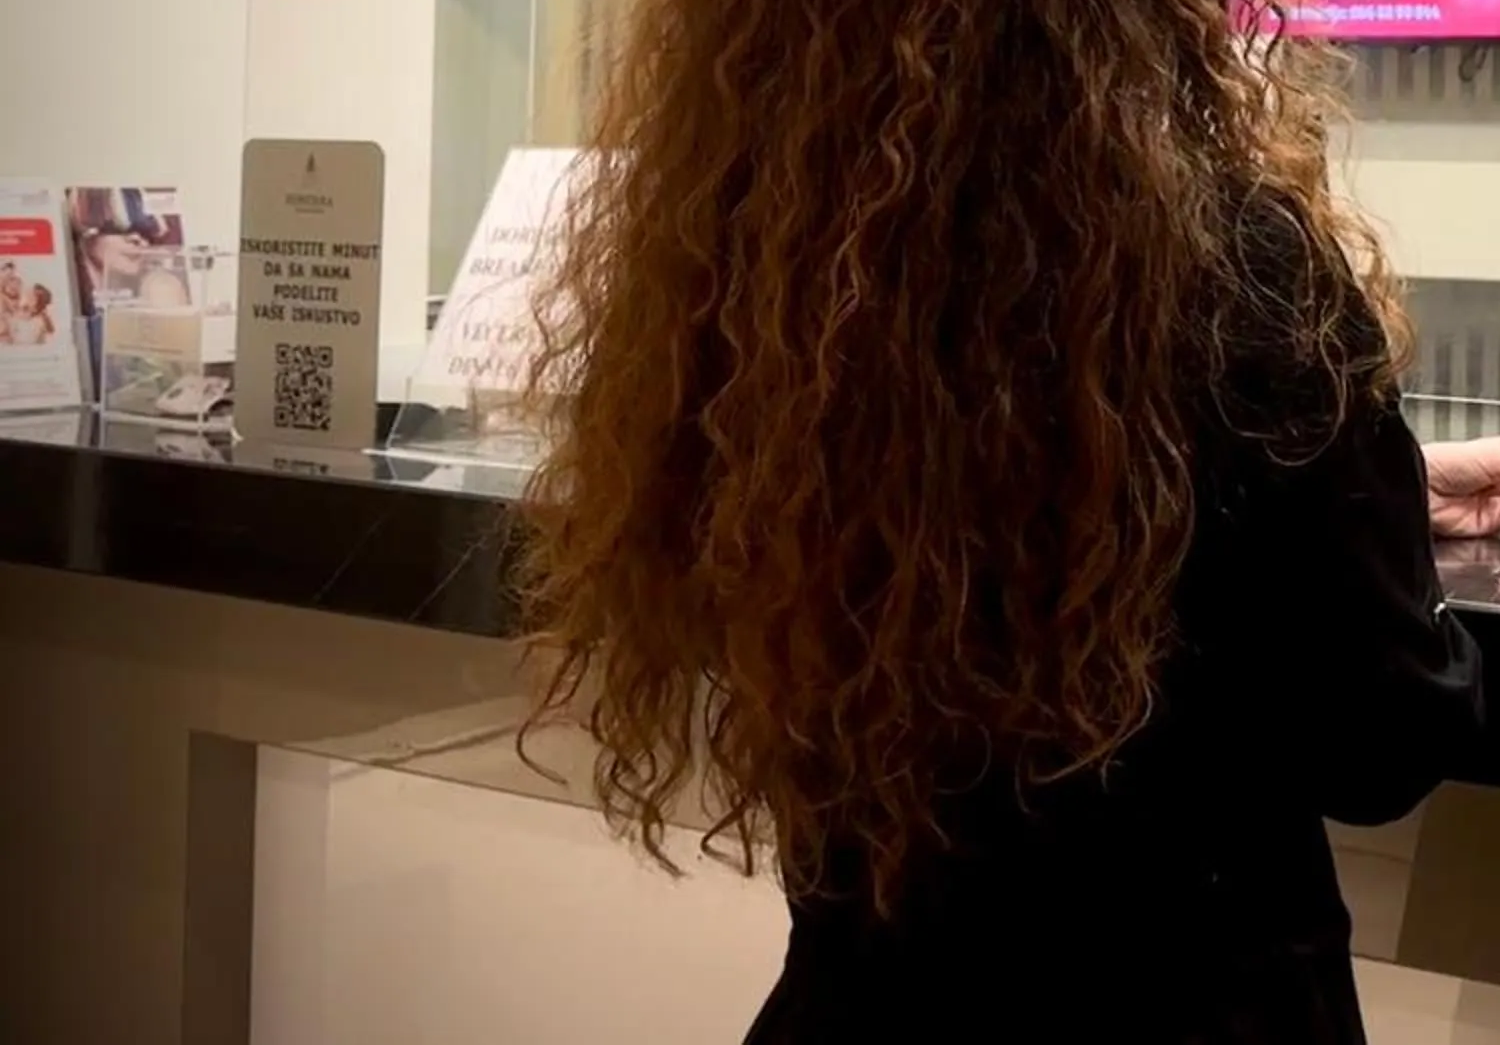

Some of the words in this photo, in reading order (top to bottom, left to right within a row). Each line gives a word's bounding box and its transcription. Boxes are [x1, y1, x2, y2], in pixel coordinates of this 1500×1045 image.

[240, 237, 325, 257] ISKORISTITE
[332, 242, 381, 260] MINUT
[263, 260, 282, 278] DA
[288, 261, 304, 278] SA
[311, 264, 352, 281] NAMA
[273, 283, 339, 303] PODELITE
[252, 301, 285, 321] VAŠE
[291, 306, 362, 327] ISKUSTVO
